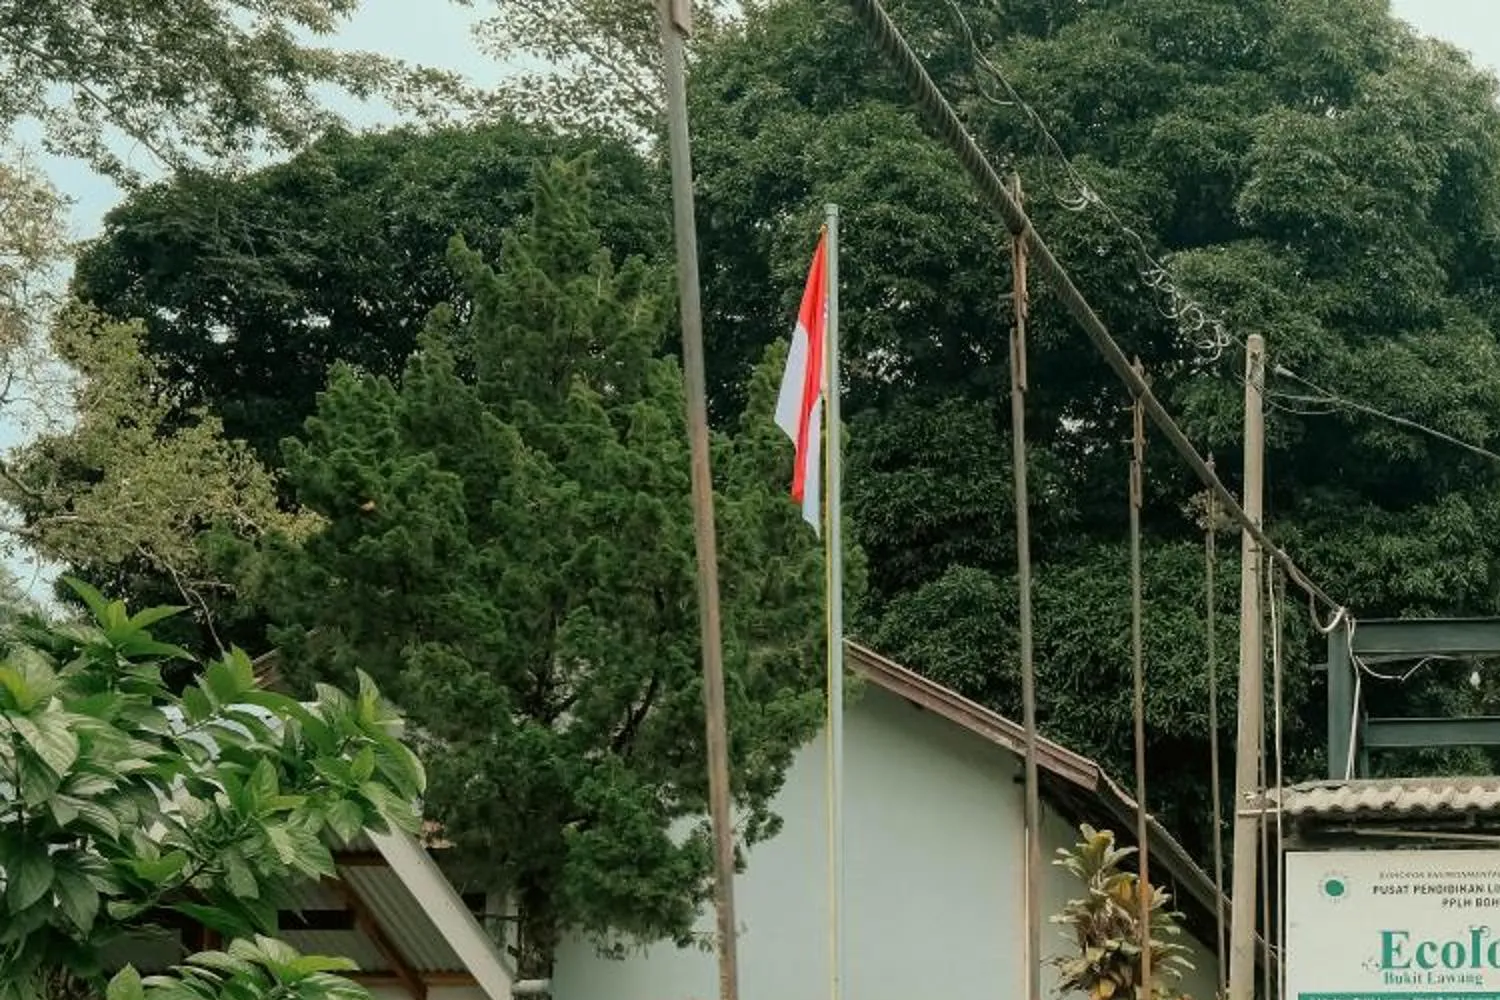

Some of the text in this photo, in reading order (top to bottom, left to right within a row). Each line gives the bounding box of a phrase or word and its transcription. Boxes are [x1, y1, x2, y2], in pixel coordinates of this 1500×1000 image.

[1373, 884, 1409, 894] PUSAT
[1413, 884, 1483, 894] PENDIDIKAN
[1442, 897, 1472, 907] PPLH
[1384, 971, 1484, 985] Bukit Lawang
